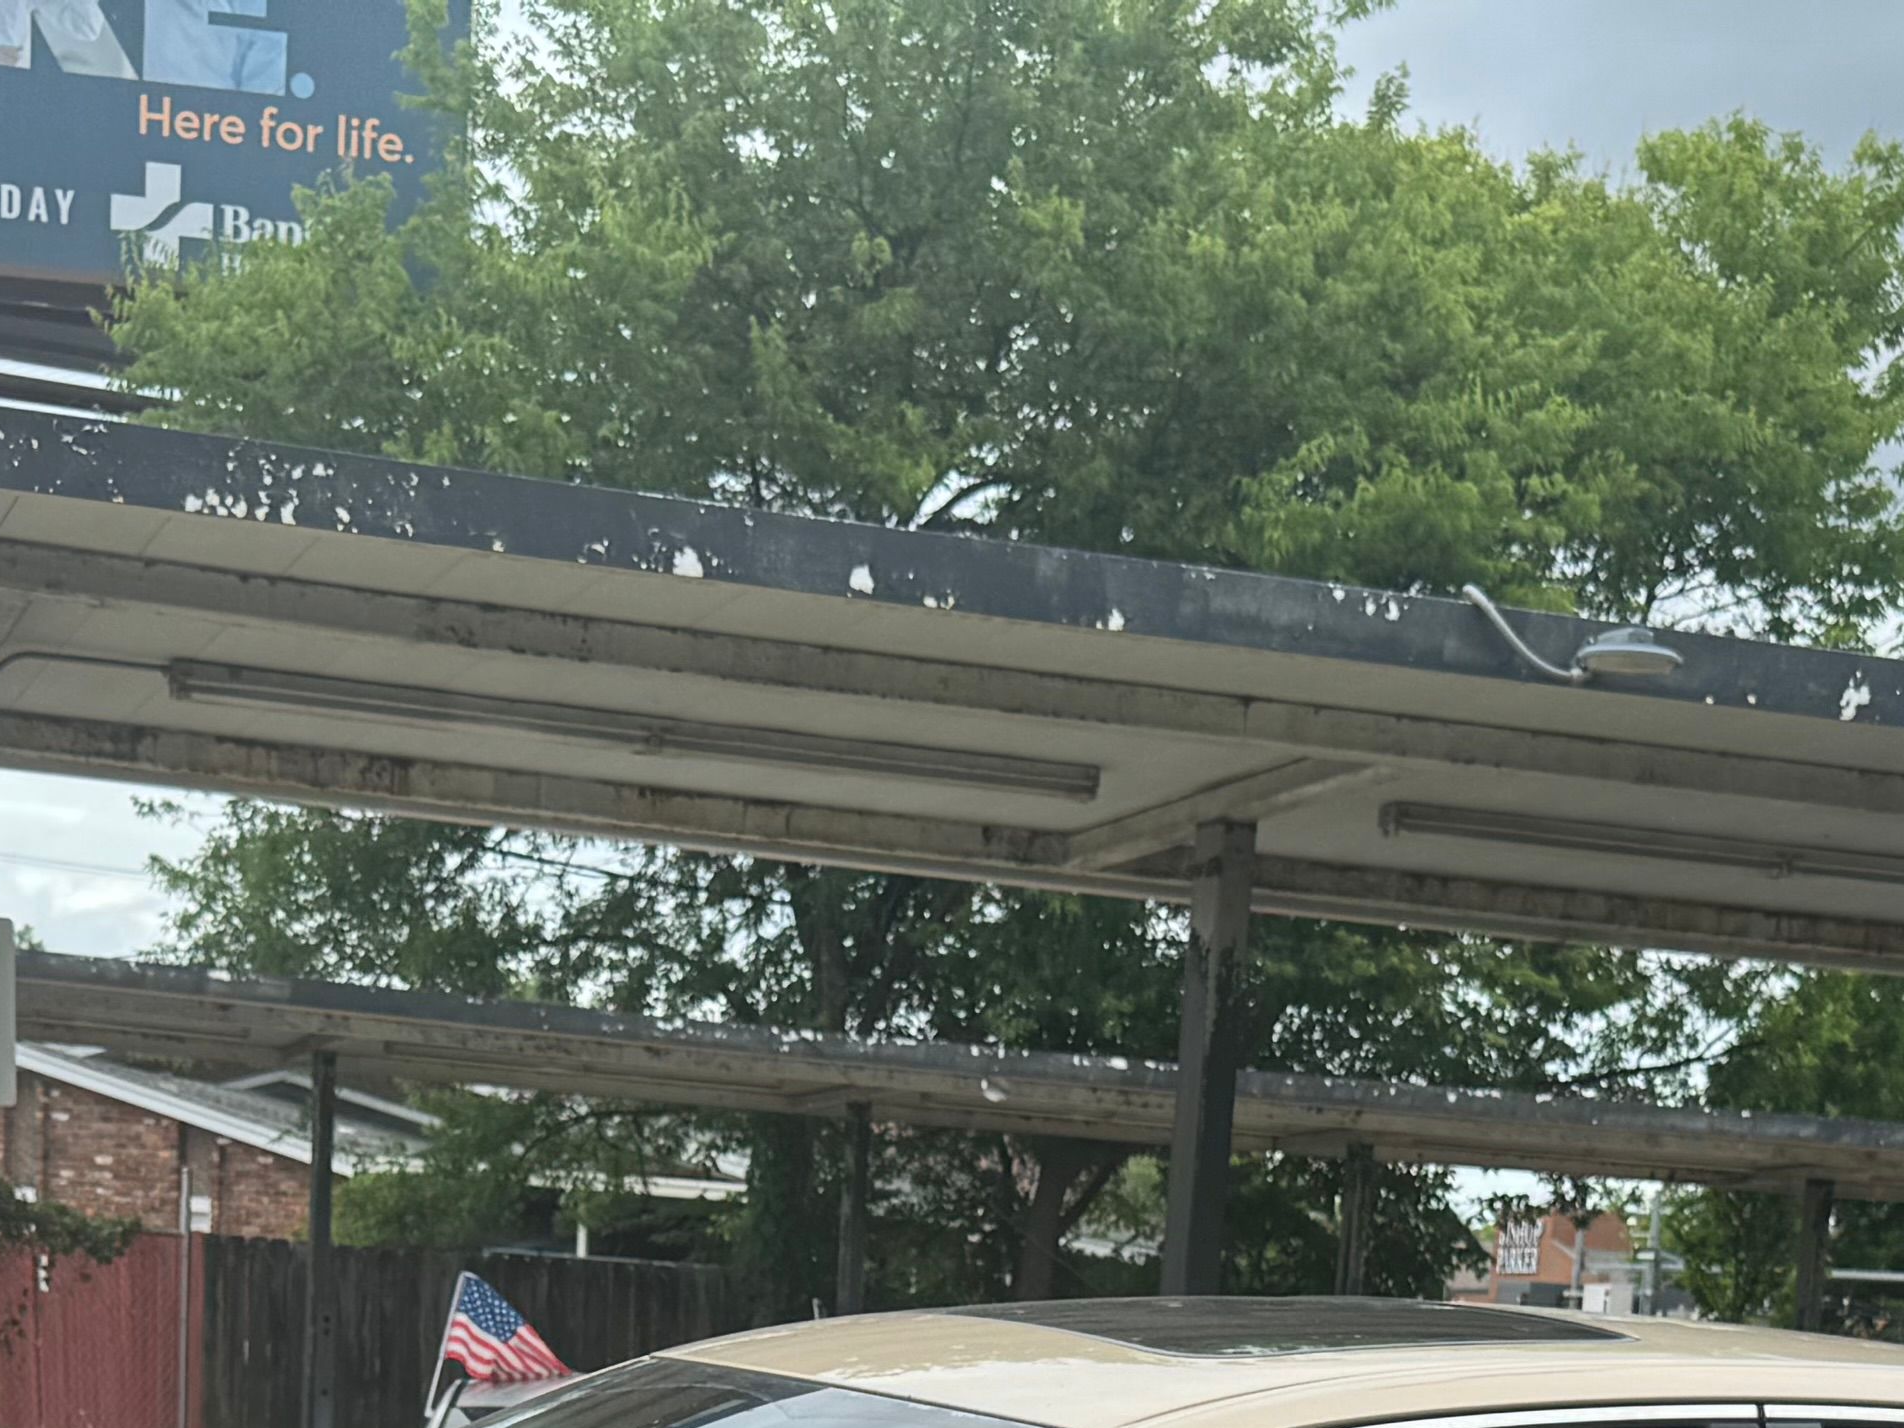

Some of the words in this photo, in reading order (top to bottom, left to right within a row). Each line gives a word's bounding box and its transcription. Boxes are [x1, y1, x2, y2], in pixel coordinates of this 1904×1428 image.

[138, 94, 246, 145] Here
[260, 106, 324, 152] for
[337, 114, 415, 164] life.
[0, 183, 76, 226] DAY
